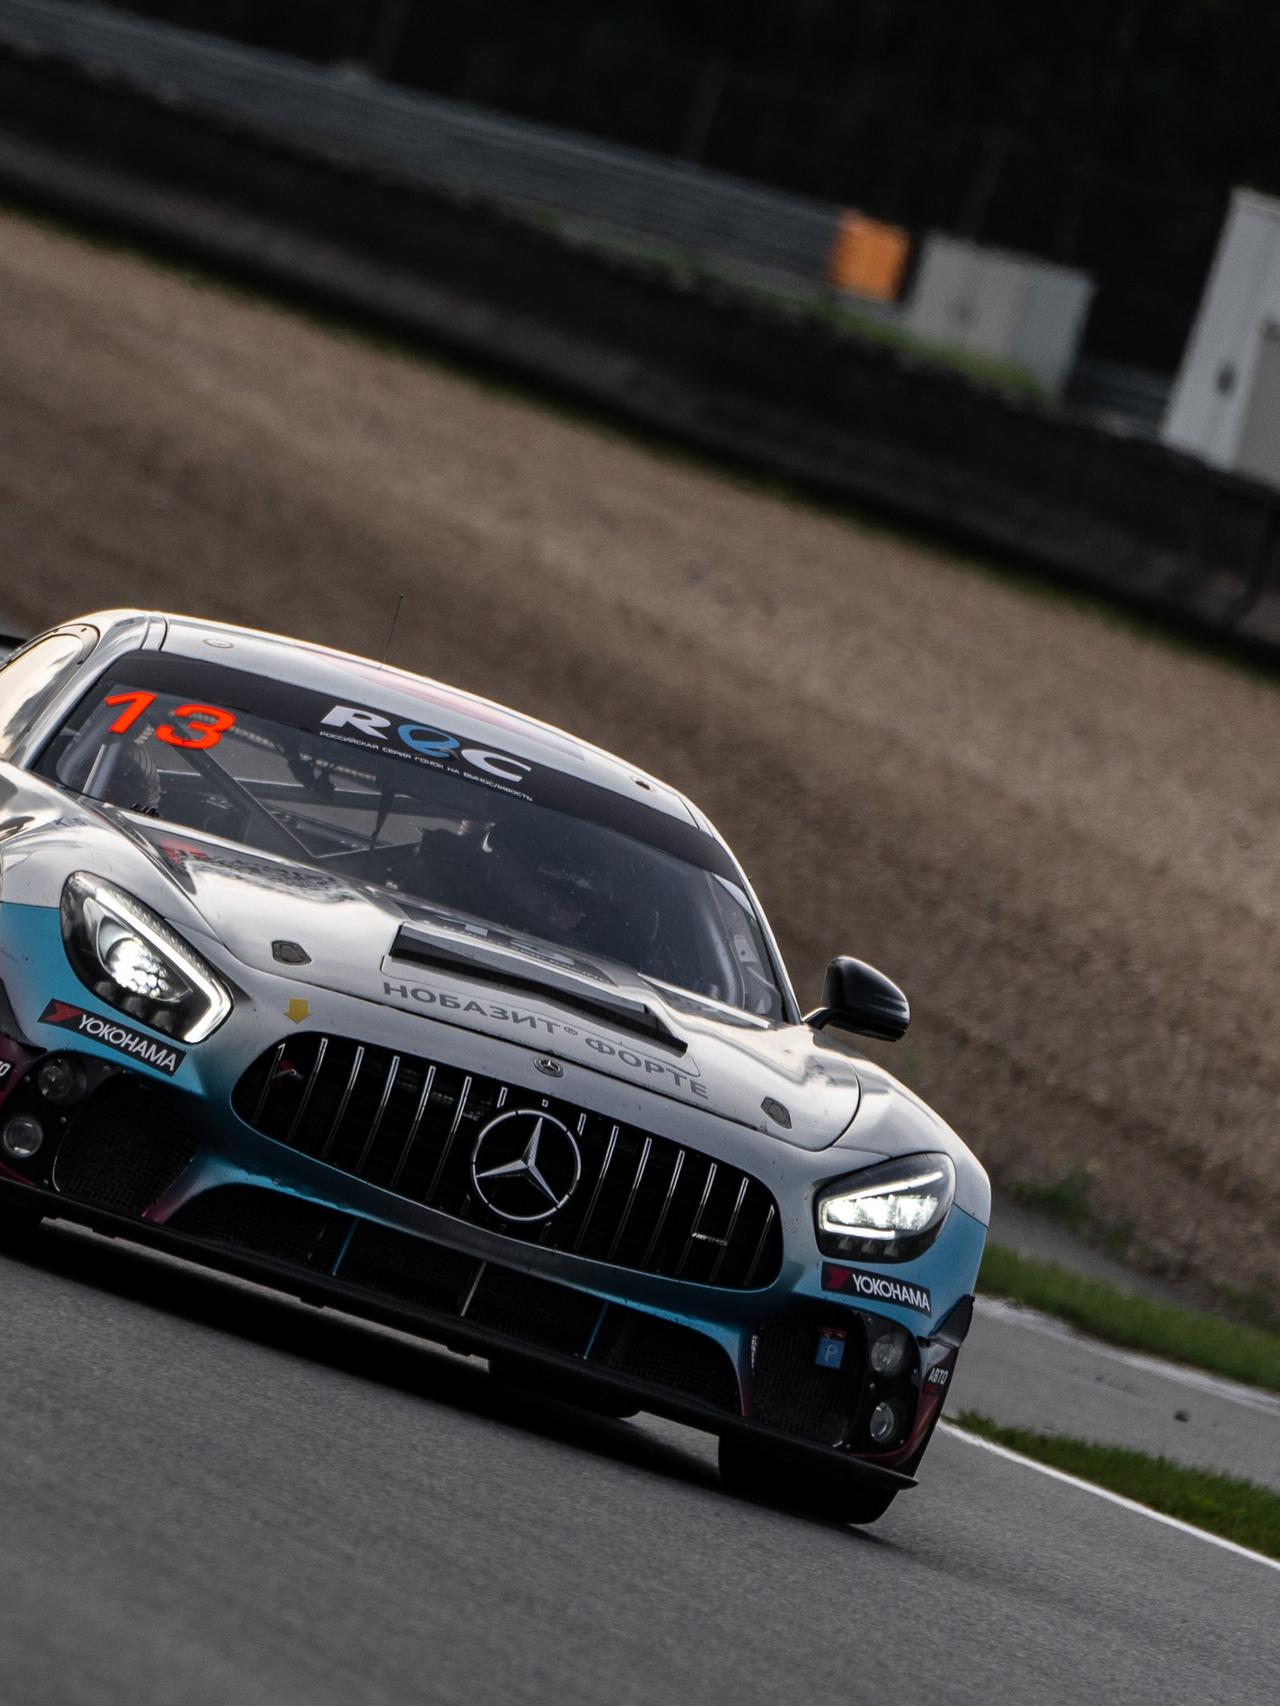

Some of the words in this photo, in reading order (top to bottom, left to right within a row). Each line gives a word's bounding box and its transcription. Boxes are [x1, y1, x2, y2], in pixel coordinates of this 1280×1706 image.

[104, 691, 236, 750] 13
[320, 731, 380, 751] РОССИЙСКАЯ
[382, 747, 412, 760] СЕРИЯ
[414, 756, 444, 770] ГОНОК
[446, 766, 461, 776] НА
[463, 771, 533, 802] ВЫНОСЛИВОСТЬ
[78, 1014, 177, 1072] YOKOHAMA
[585, 1037, 708, 1100] ФОРТЕ
[852, 1273, 931, 1312] YOKOHAMA
[928, 1367, 949, 1386] АВТО
